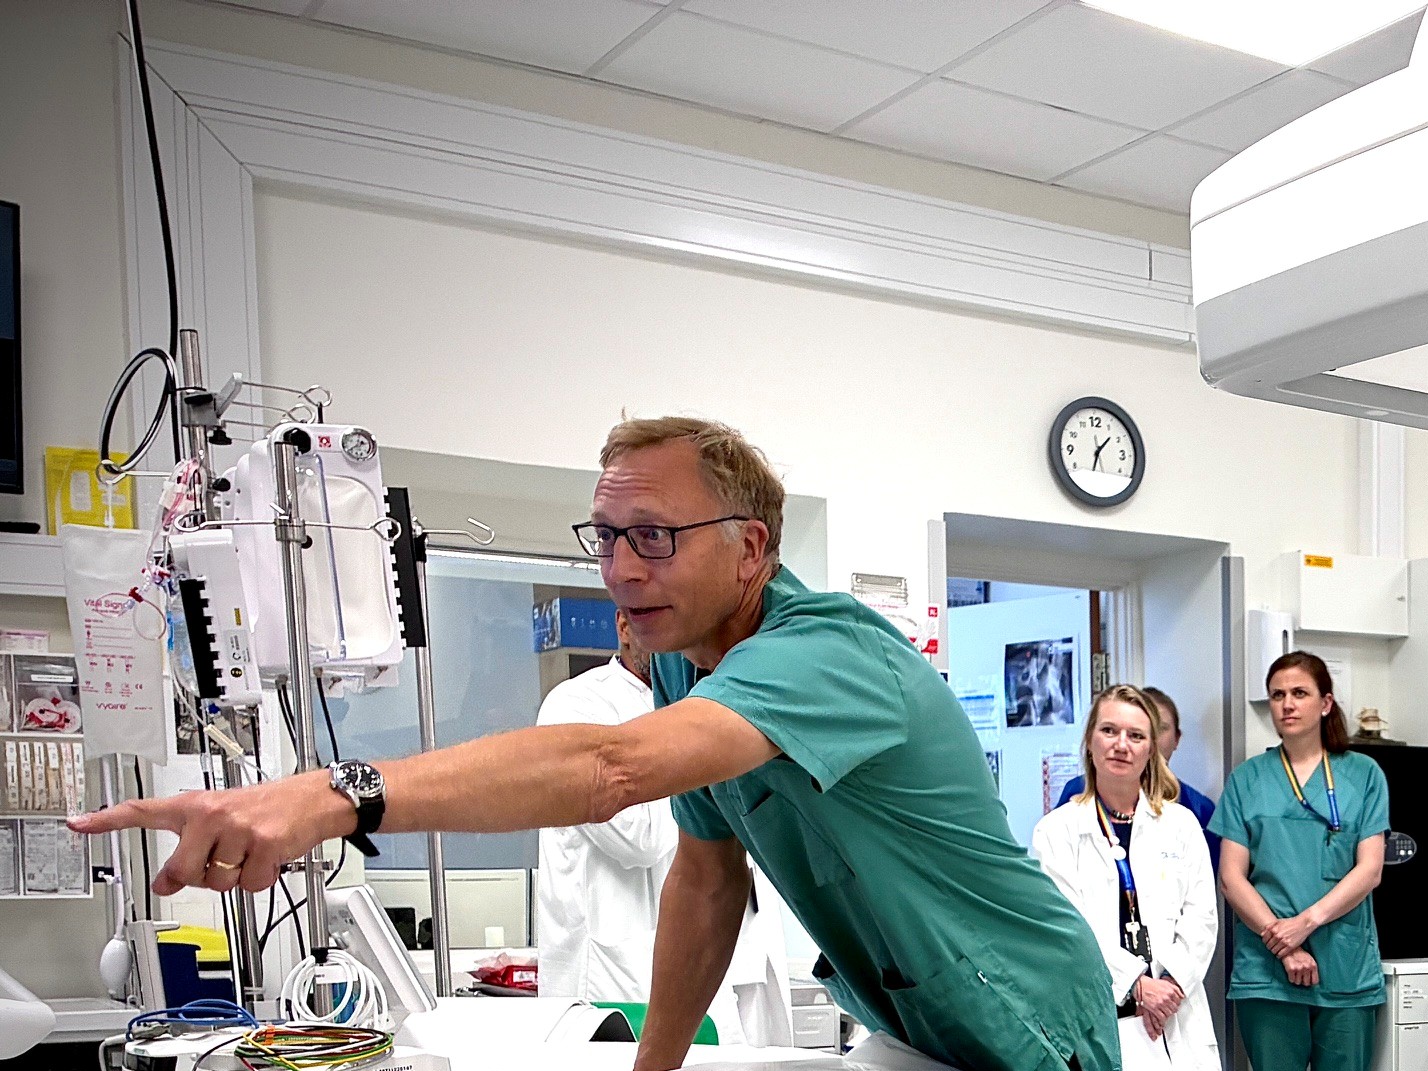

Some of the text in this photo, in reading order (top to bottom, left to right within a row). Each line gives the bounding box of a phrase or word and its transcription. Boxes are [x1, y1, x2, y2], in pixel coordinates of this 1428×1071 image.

[1088, 416, 1102, 428] 12
[1066, 444, 1075, 455] 9
[1119, 449, 1126, 461] 3
